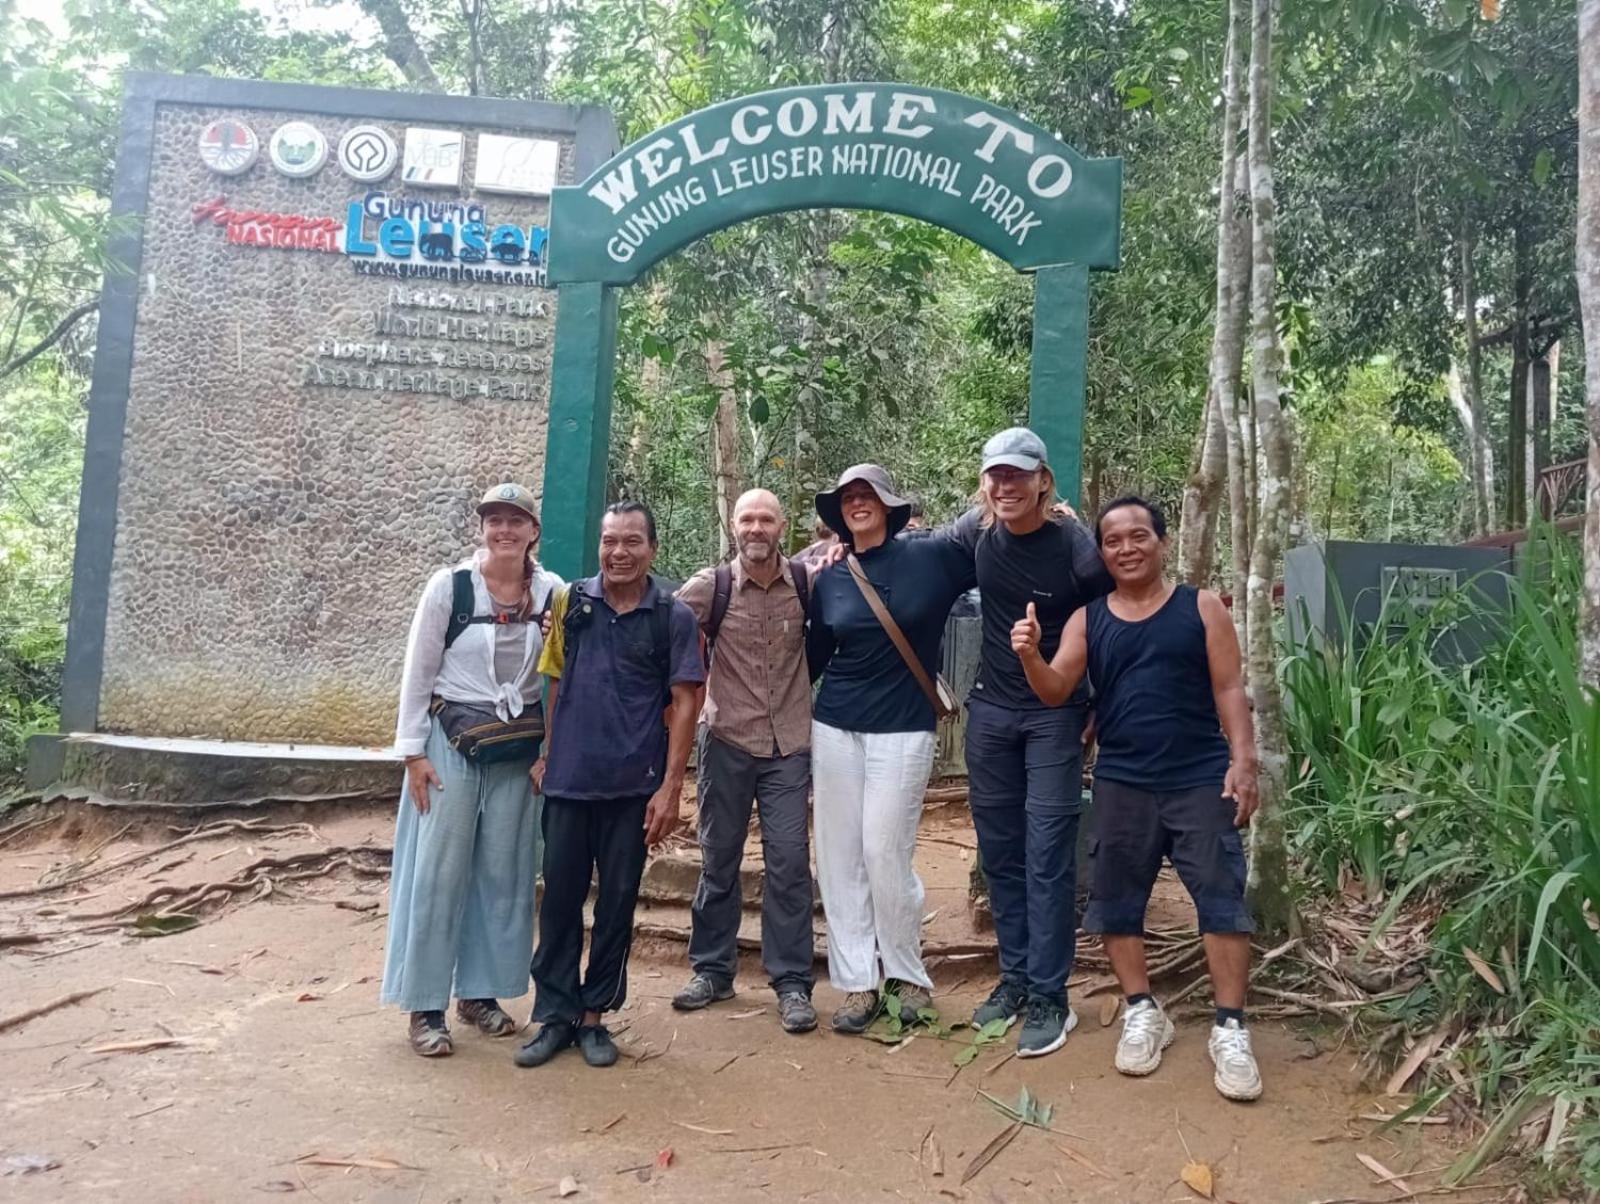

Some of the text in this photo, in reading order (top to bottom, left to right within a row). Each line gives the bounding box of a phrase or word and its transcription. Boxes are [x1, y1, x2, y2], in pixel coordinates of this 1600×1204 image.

[587, 92, 1074, 215] WELCOME TO
[346, 202, 549, 266] Leuser
[364, 191, 486, 226] Gunung
[606, 143, 1043, 264] GUNUNG LEUSER NATIONAL PARK
[227, 222, 341, 253] NASIONAL
